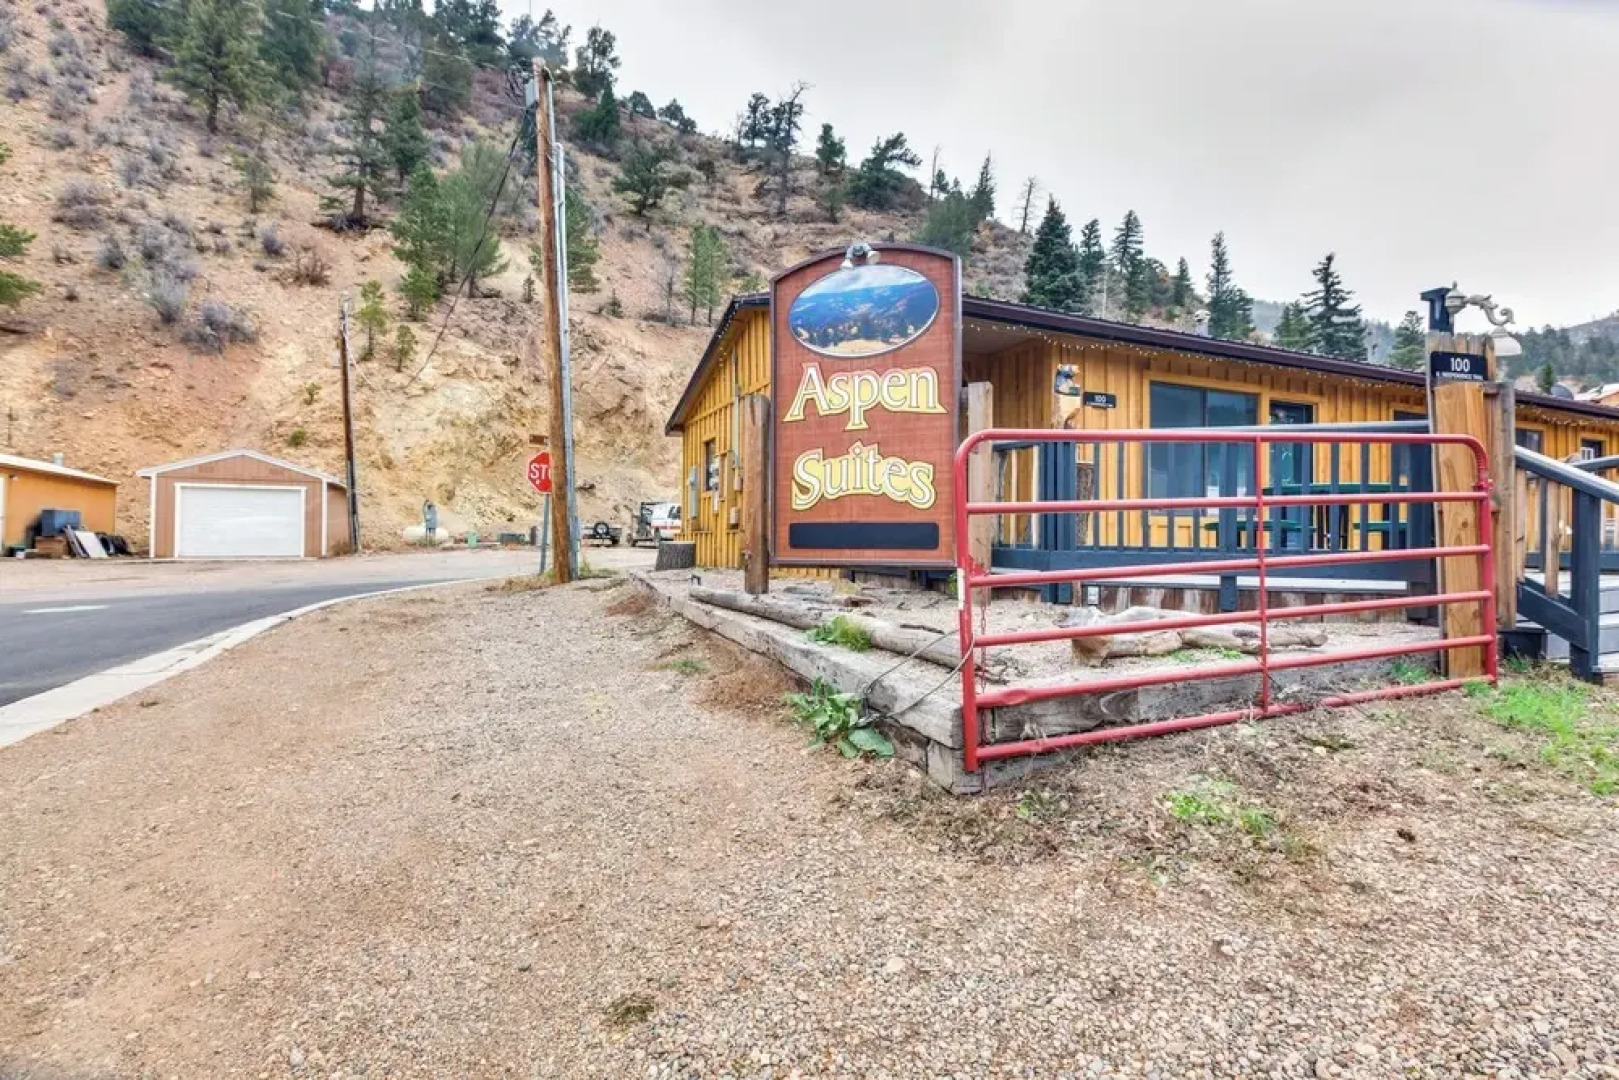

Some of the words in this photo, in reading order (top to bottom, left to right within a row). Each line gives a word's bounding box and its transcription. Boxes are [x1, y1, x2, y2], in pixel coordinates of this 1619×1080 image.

[1450, 357, 1471, 373] 100
[783, 362, 947, 430] Aspen
[530, 463, 551, 480] ST
[791, 440, 937, 511] Suites
